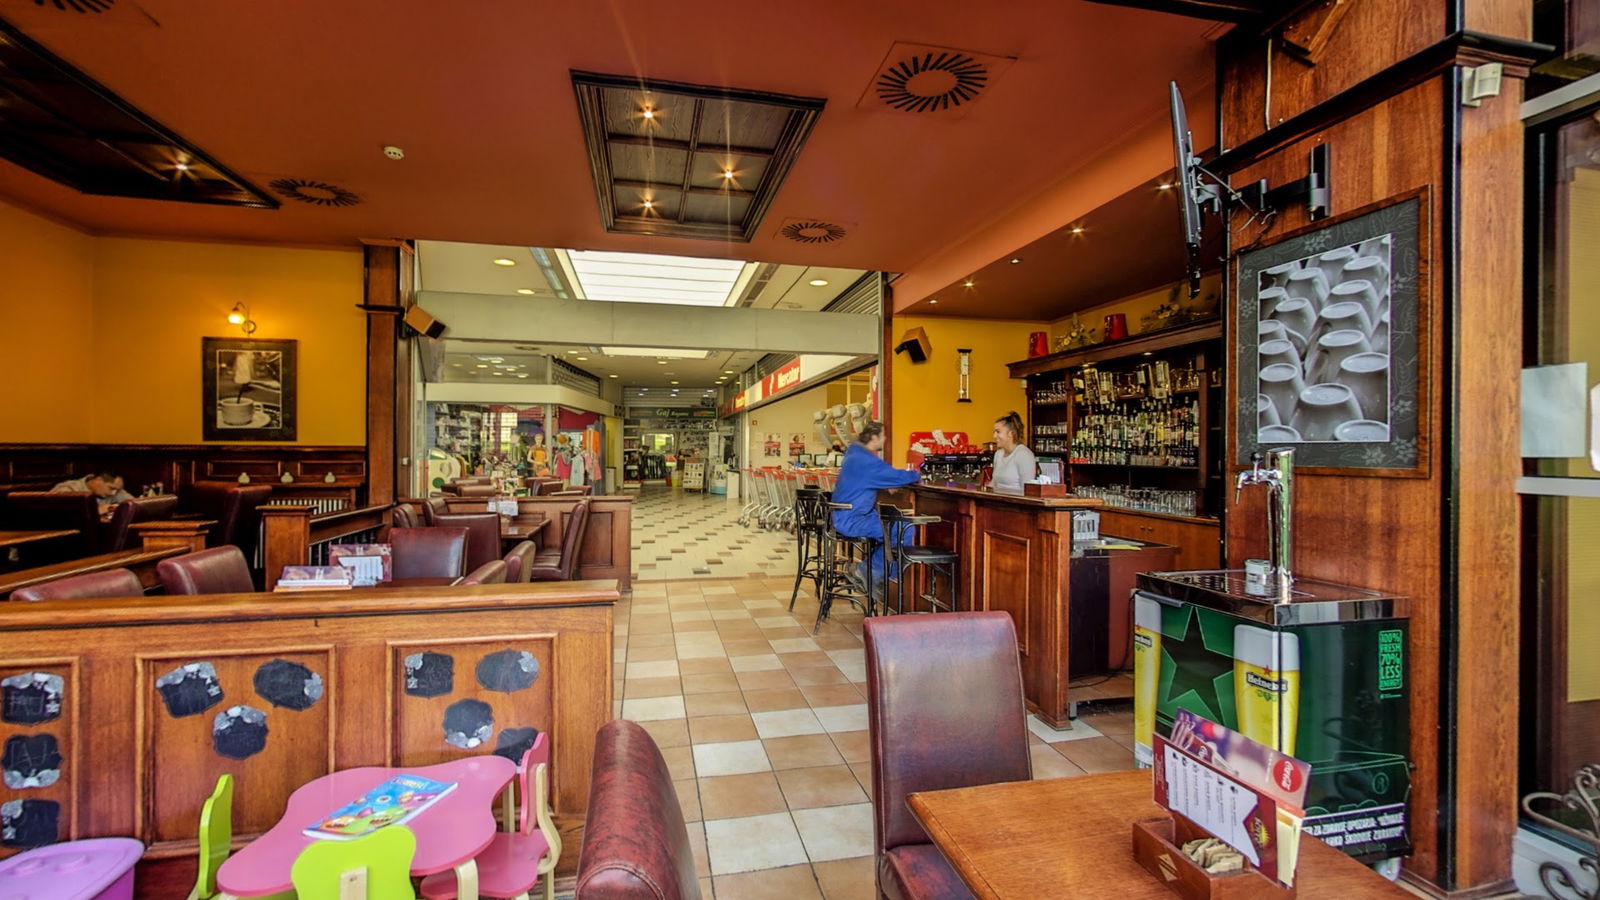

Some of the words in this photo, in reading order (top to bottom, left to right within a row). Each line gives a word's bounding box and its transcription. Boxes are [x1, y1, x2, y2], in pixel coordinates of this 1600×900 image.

[1380, 643, 1401, 653] FRESH
[1380, 653, 1401, 666] 70%
[1380, 665, 1401, 680] LESS
